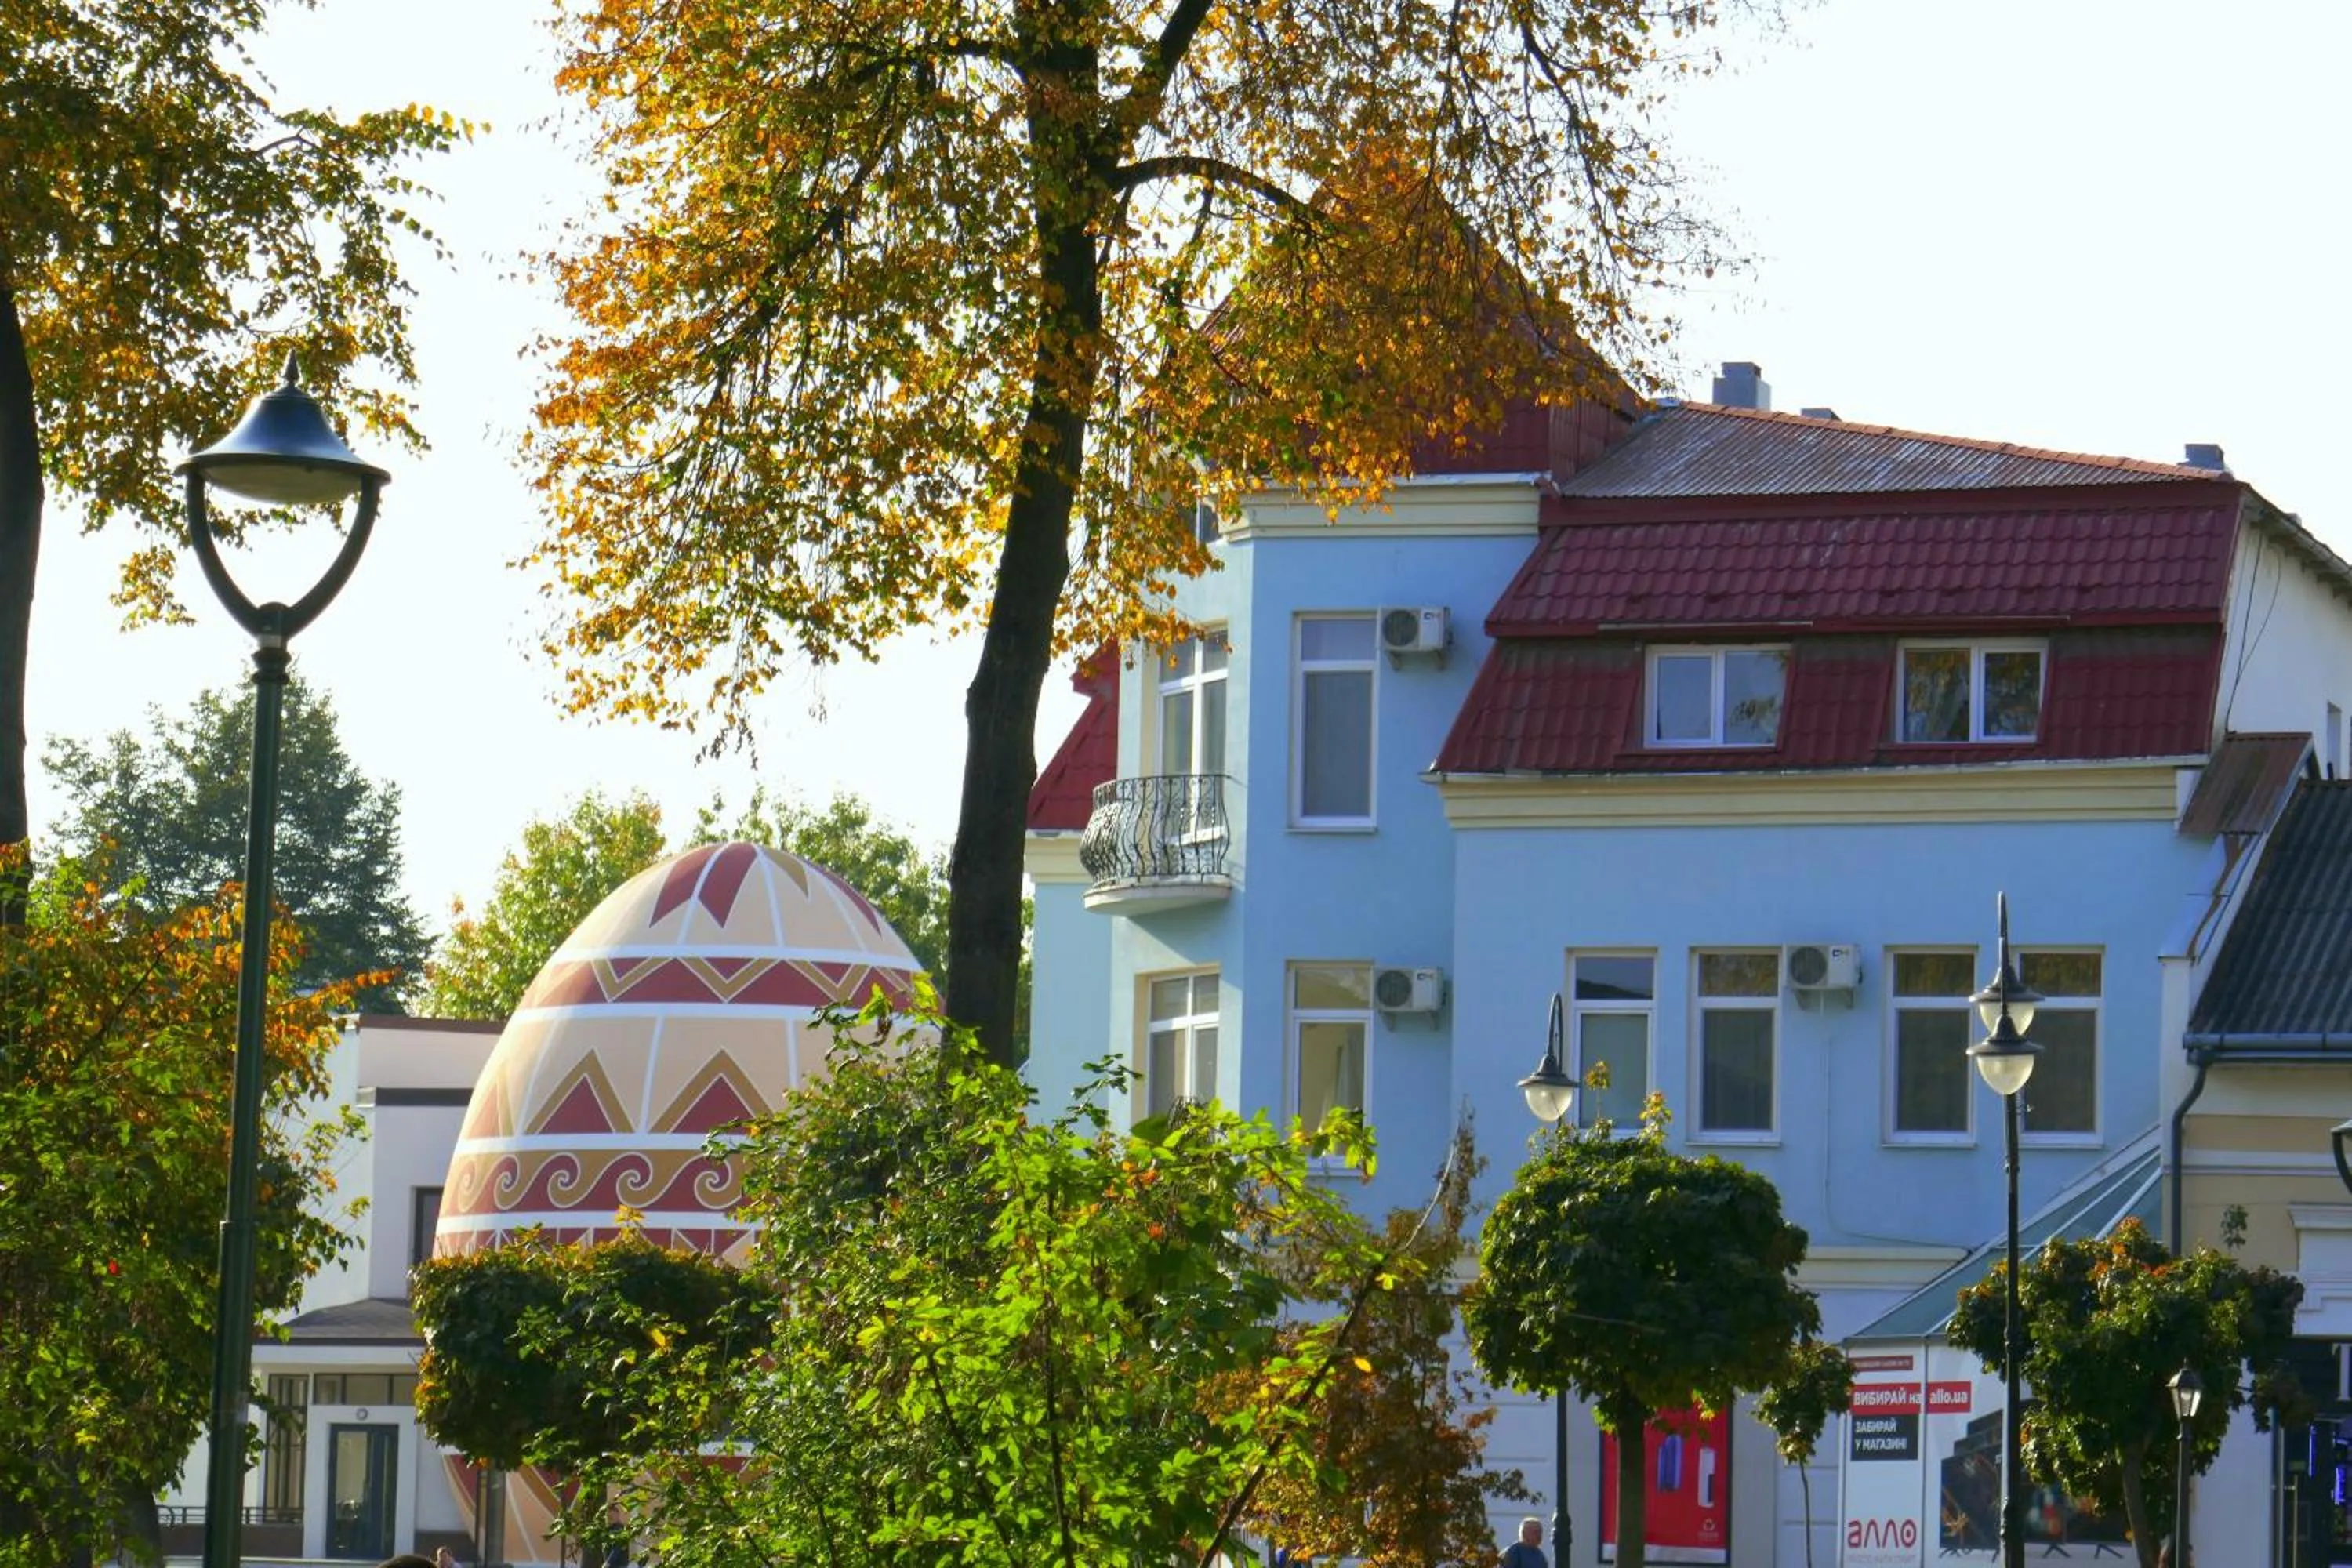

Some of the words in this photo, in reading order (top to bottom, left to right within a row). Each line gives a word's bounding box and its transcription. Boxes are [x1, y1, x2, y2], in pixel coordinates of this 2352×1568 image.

[1853, 1387, 1907, 1406] ВИБИРАЙ
[1929, 1388, 1969, 1404] allo.ua
[1856, 1417, 1896, 1433] ЗАБИРАЙ
